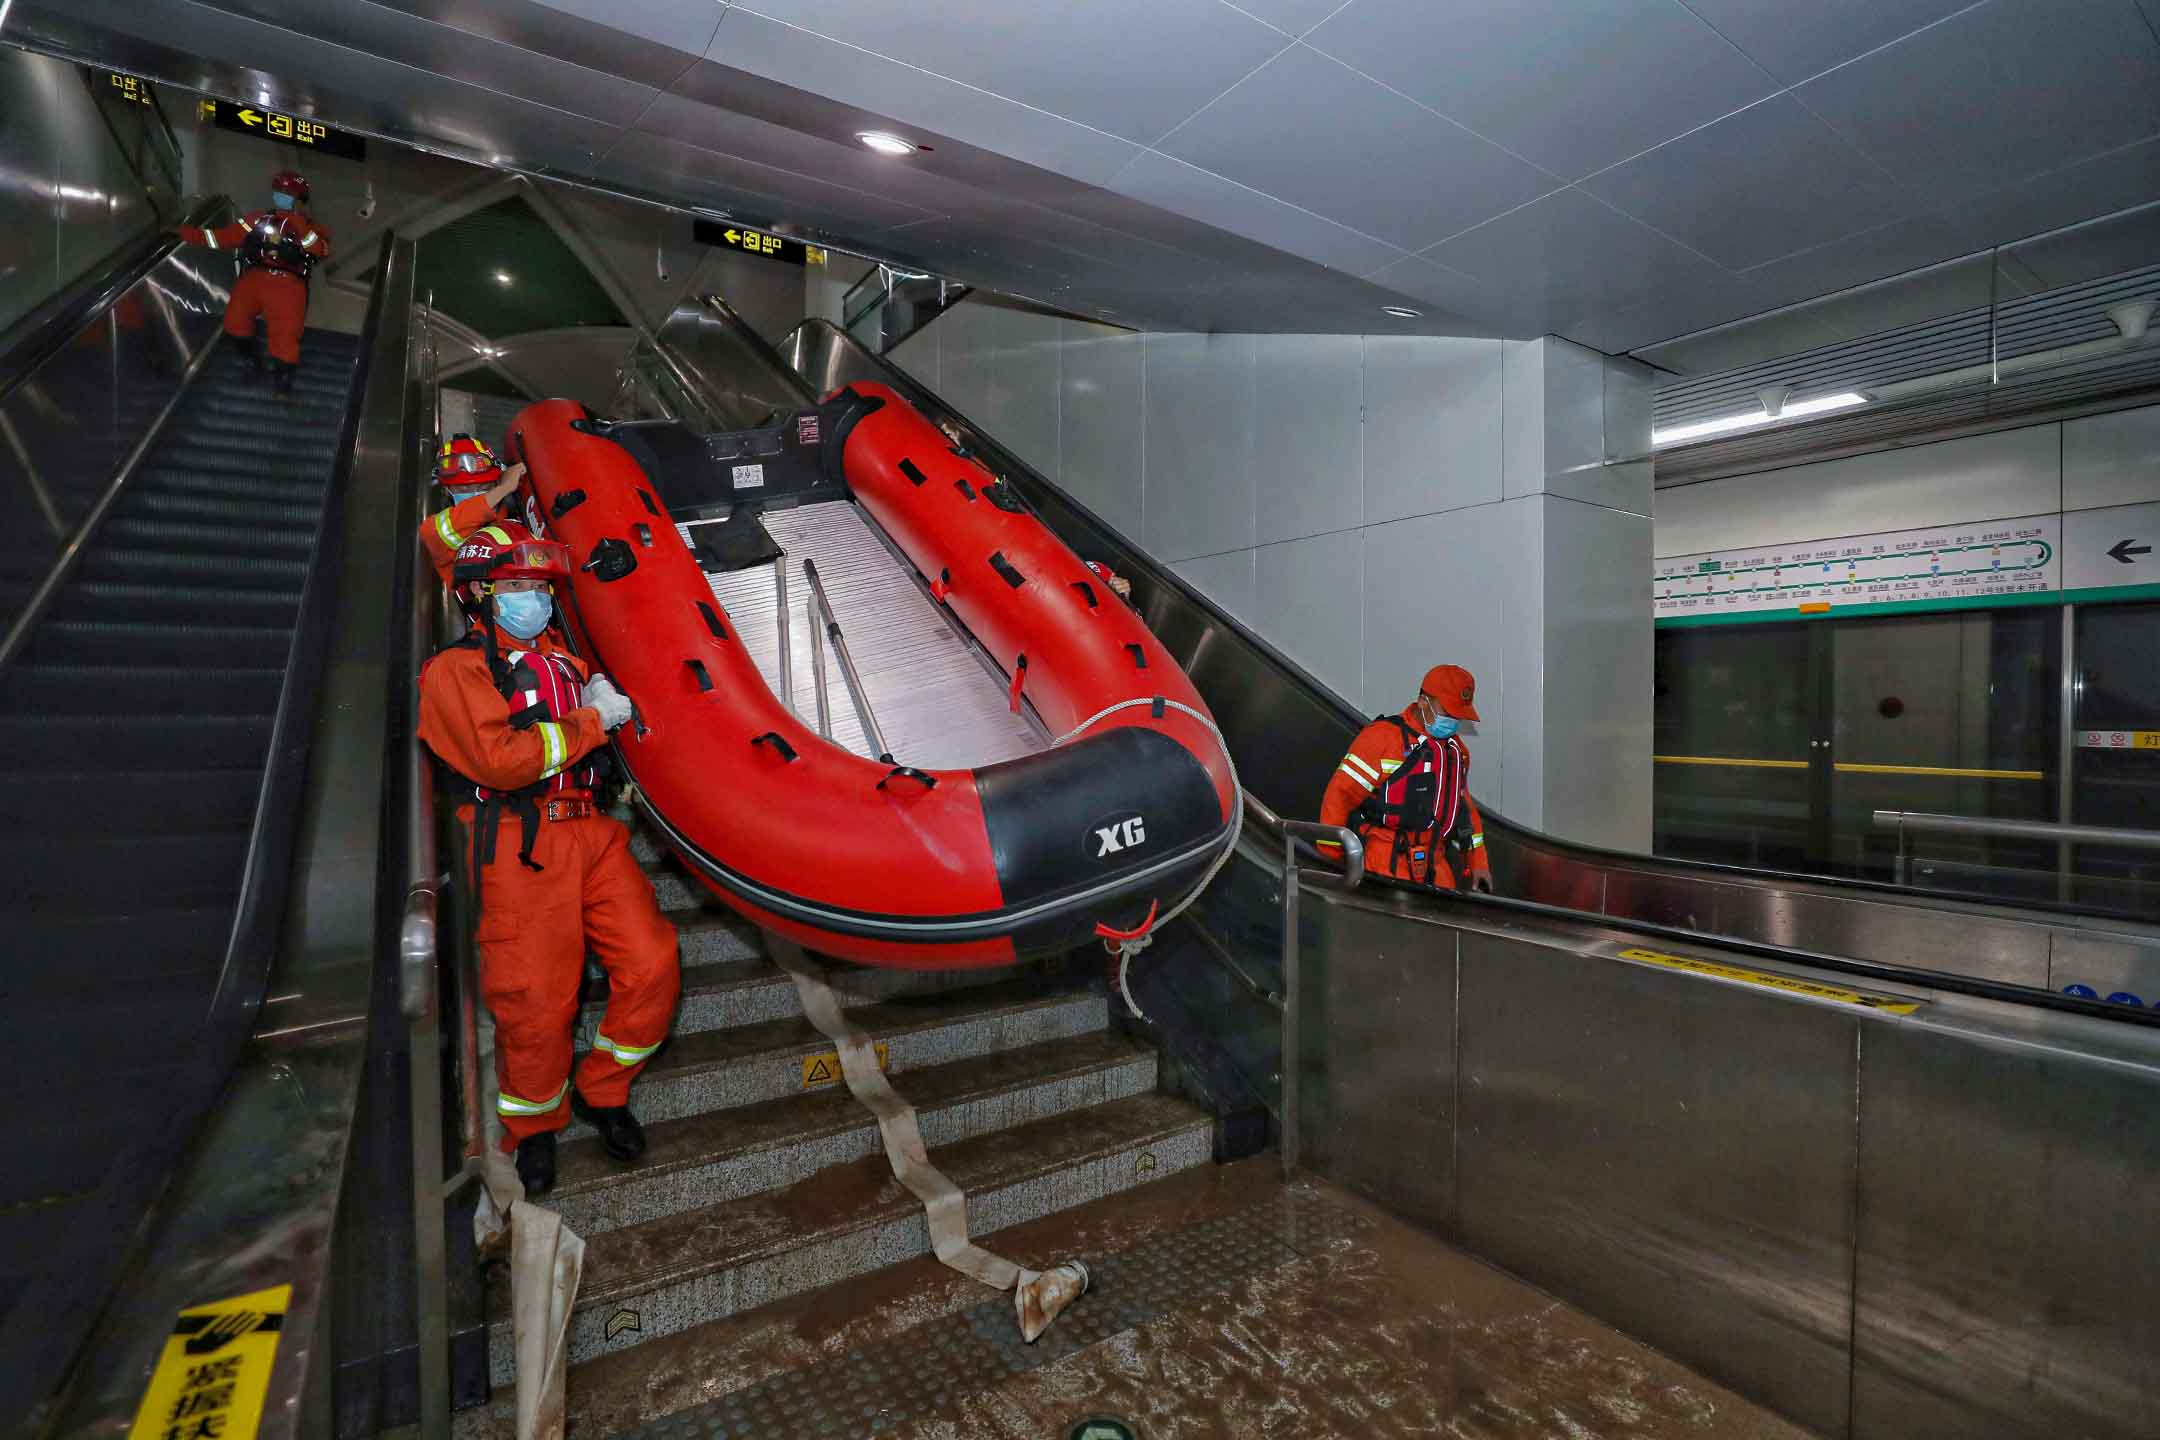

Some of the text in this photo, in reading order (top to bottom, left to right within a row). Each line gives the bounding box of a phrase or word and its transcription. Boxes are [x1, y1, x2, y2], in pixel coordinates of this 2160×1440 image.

[297, 119, 325, 138] 出口
[297, 133, 313, 144] Exit
[763, 235, 782, 249] 出口
[1095, 816, 1146, 857] XG
